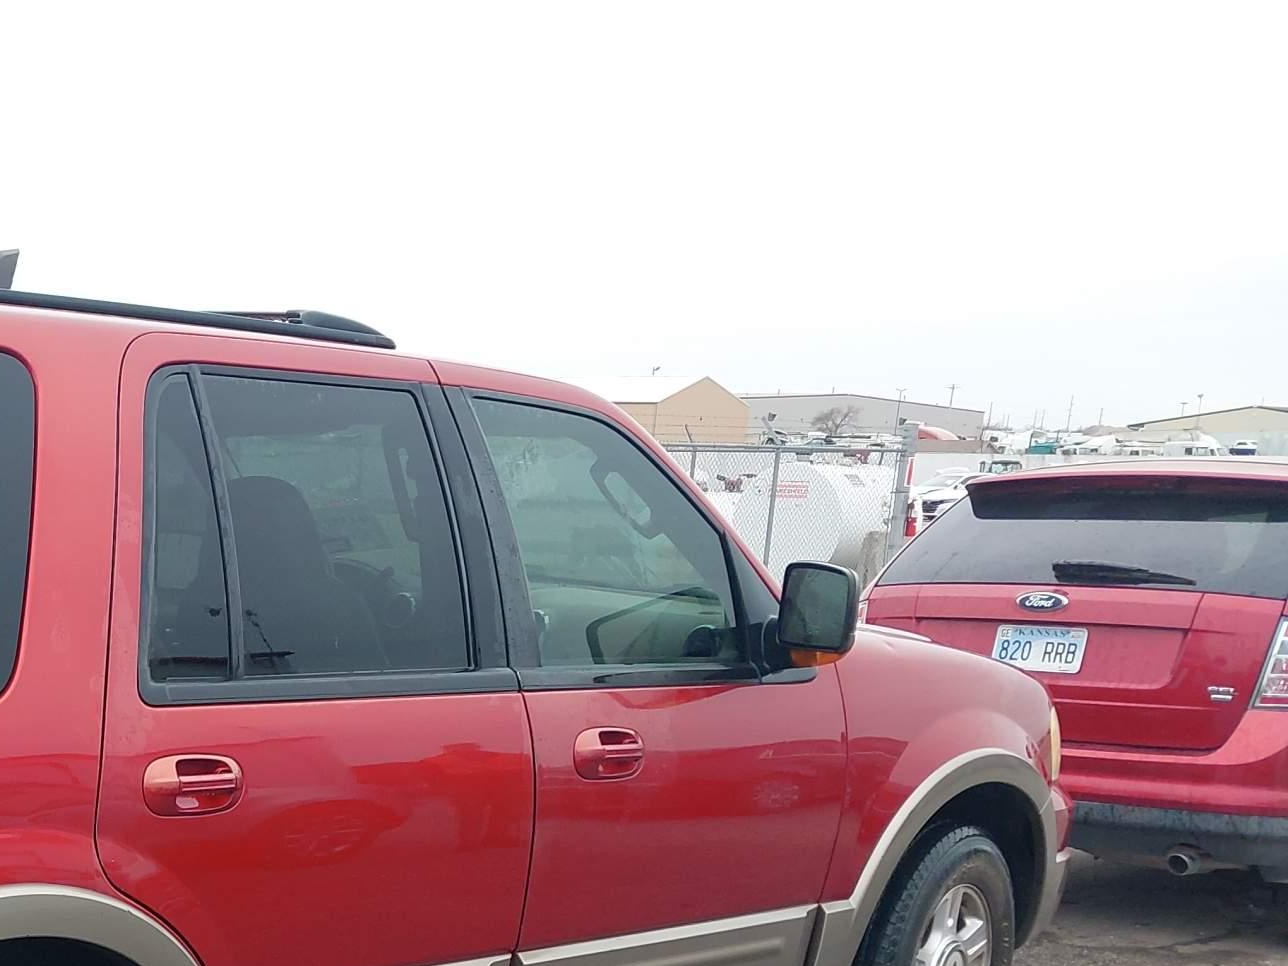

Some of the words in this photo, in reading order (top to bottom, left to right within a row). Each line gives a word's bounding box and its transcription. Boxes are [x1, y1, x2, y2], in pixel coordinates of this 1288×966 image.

[1025, 594, 1055, 608] Ford
[1018, 629, 1067, 638] KANSAS
[998, 639, 1032, 661] 820
[1041, 641, 1078, 664] RRB
